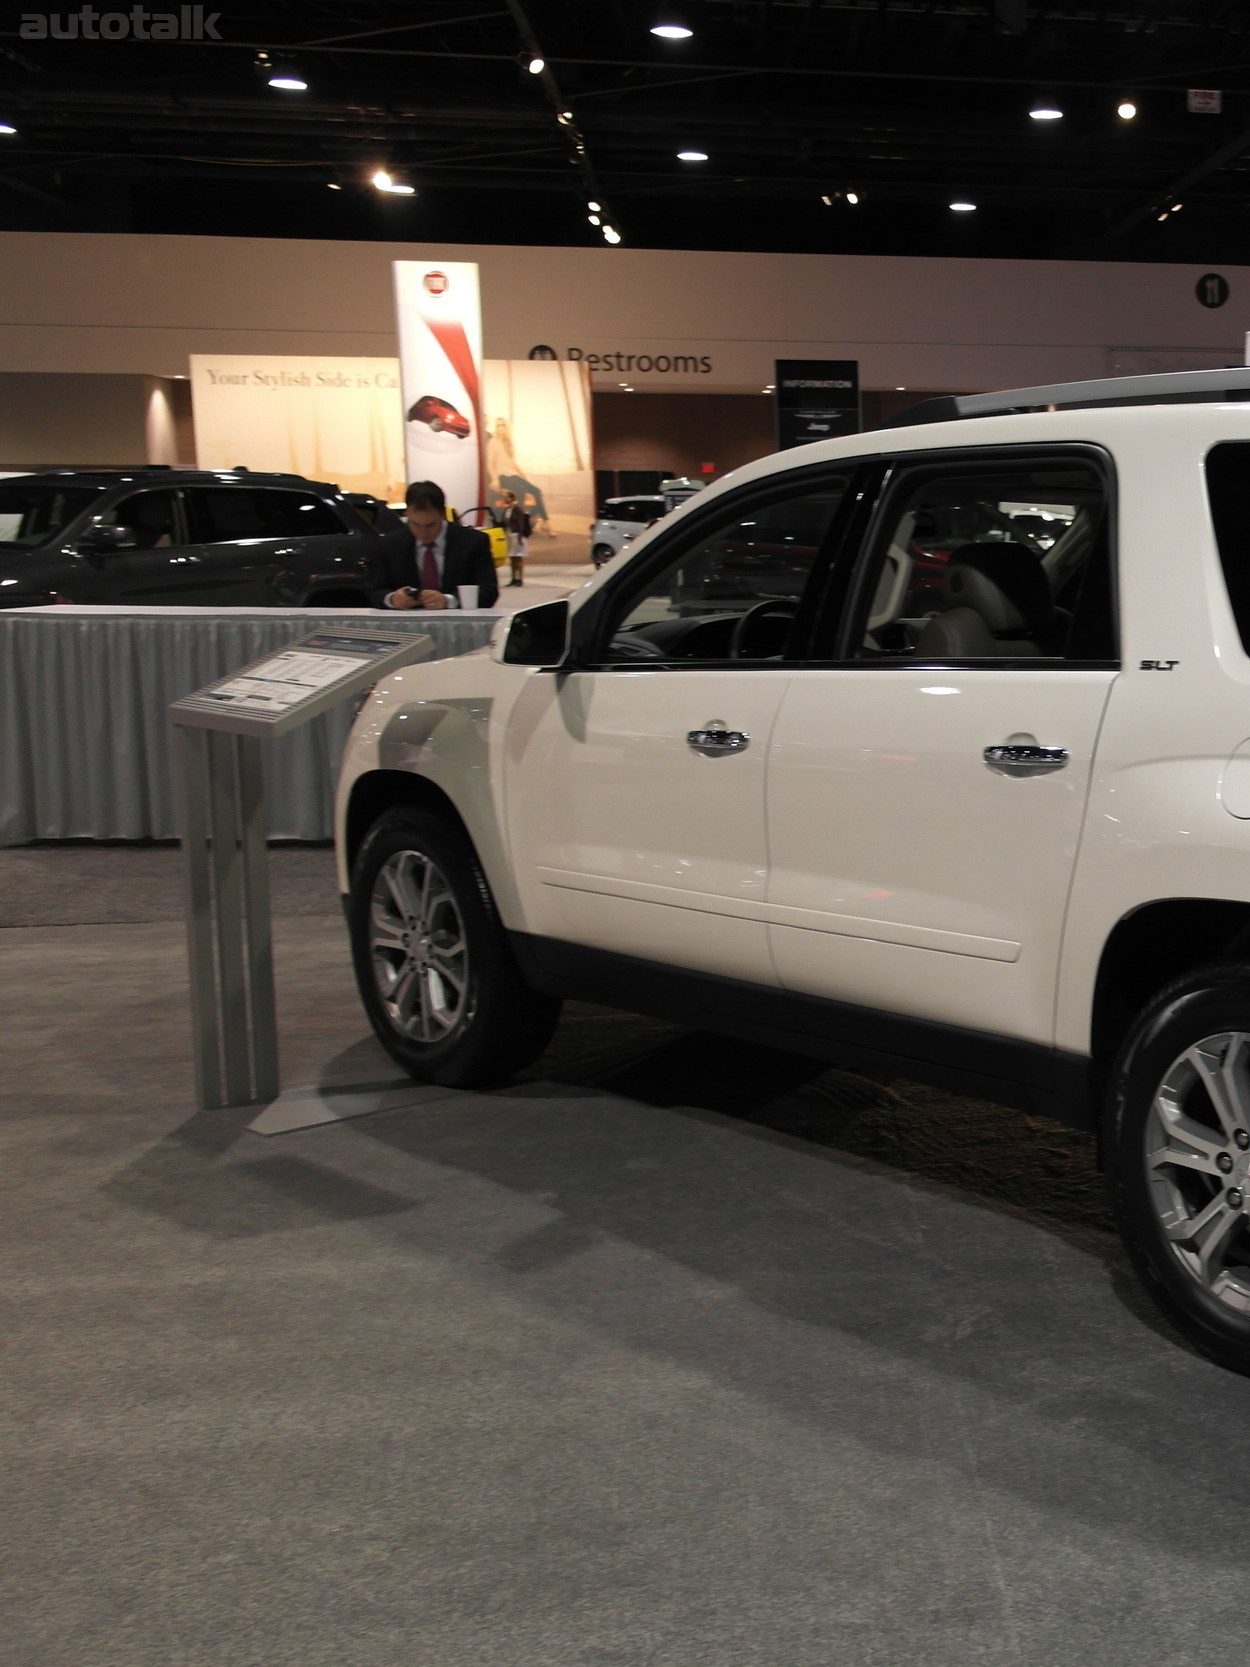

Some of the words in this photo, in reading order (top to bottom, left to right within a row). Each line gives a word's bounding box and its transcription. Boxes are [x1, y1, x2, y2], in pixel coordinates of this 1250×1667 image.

[206, 369, 248, 386] Your
[252, 370, 311, 391] Stylish
[315, 372, 352, 388] Side
[356, 373, 370, 388] is
[782, 380, 853, 389] INFORMATION
[1140, 660, 1180, 671] SLT
